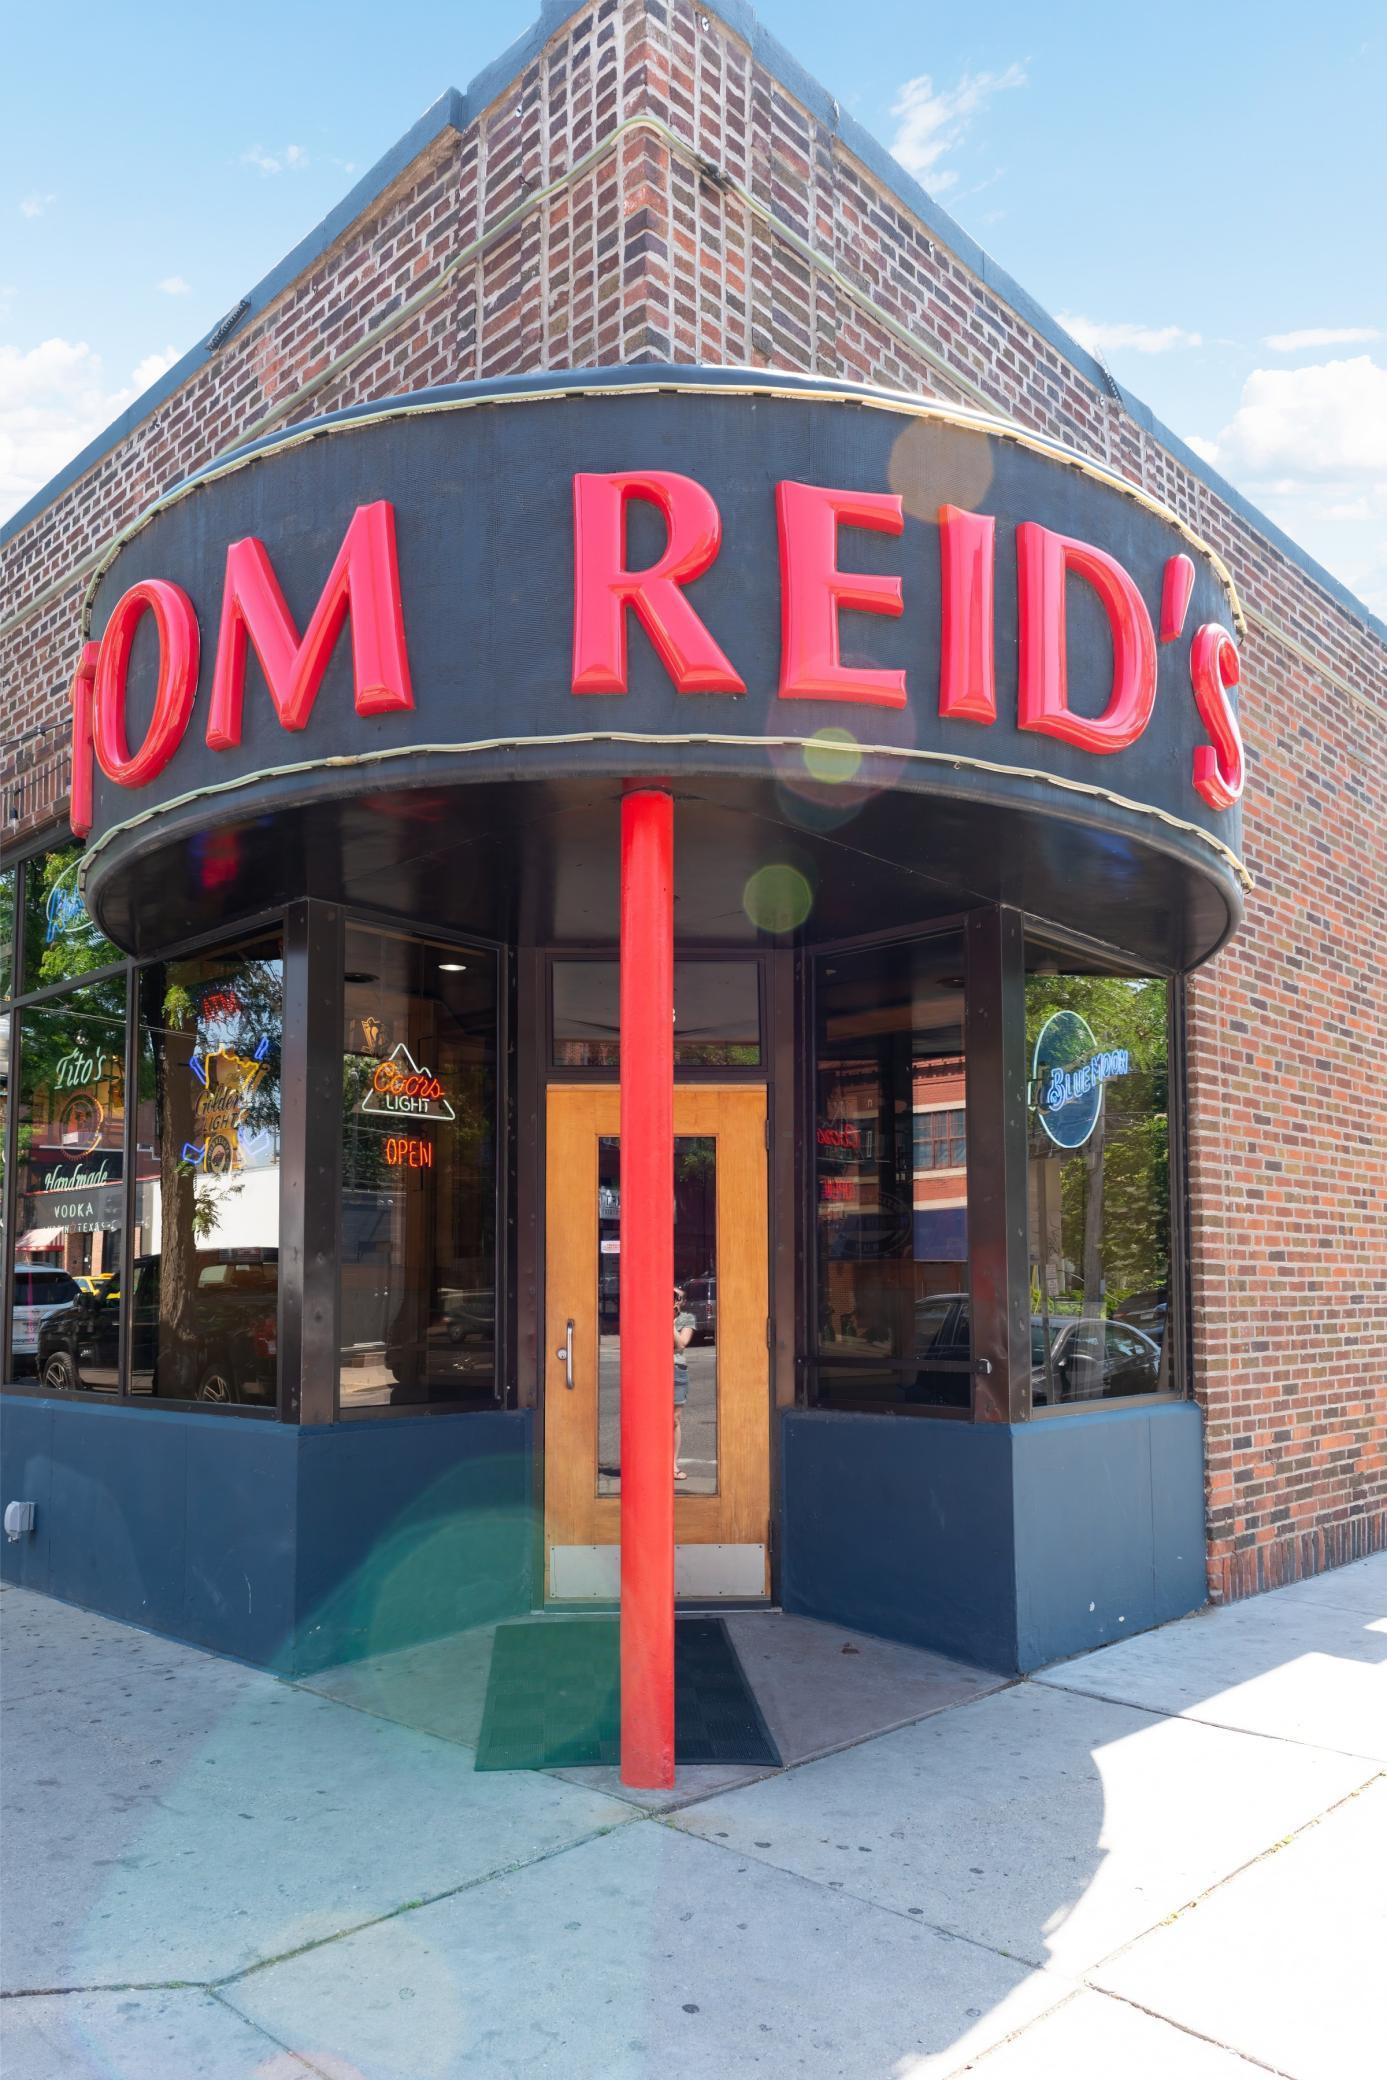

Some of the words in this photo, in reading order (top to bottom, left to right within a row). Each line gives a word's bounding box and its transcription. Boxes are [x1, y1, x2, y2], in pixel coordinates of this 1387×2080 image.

[571, 470, 1246, 812] REID'S
[54, 1045, 106, 1090] Tito's
[373, 1061, 446, 1098] Coors
[386, 1095, 431, 1113] LIGHT
[386, 1138, 432, 1168] OPEN
[44, 1158, 109, 1193] Handmade
[54, 1201, 94, 1218] VODKA
